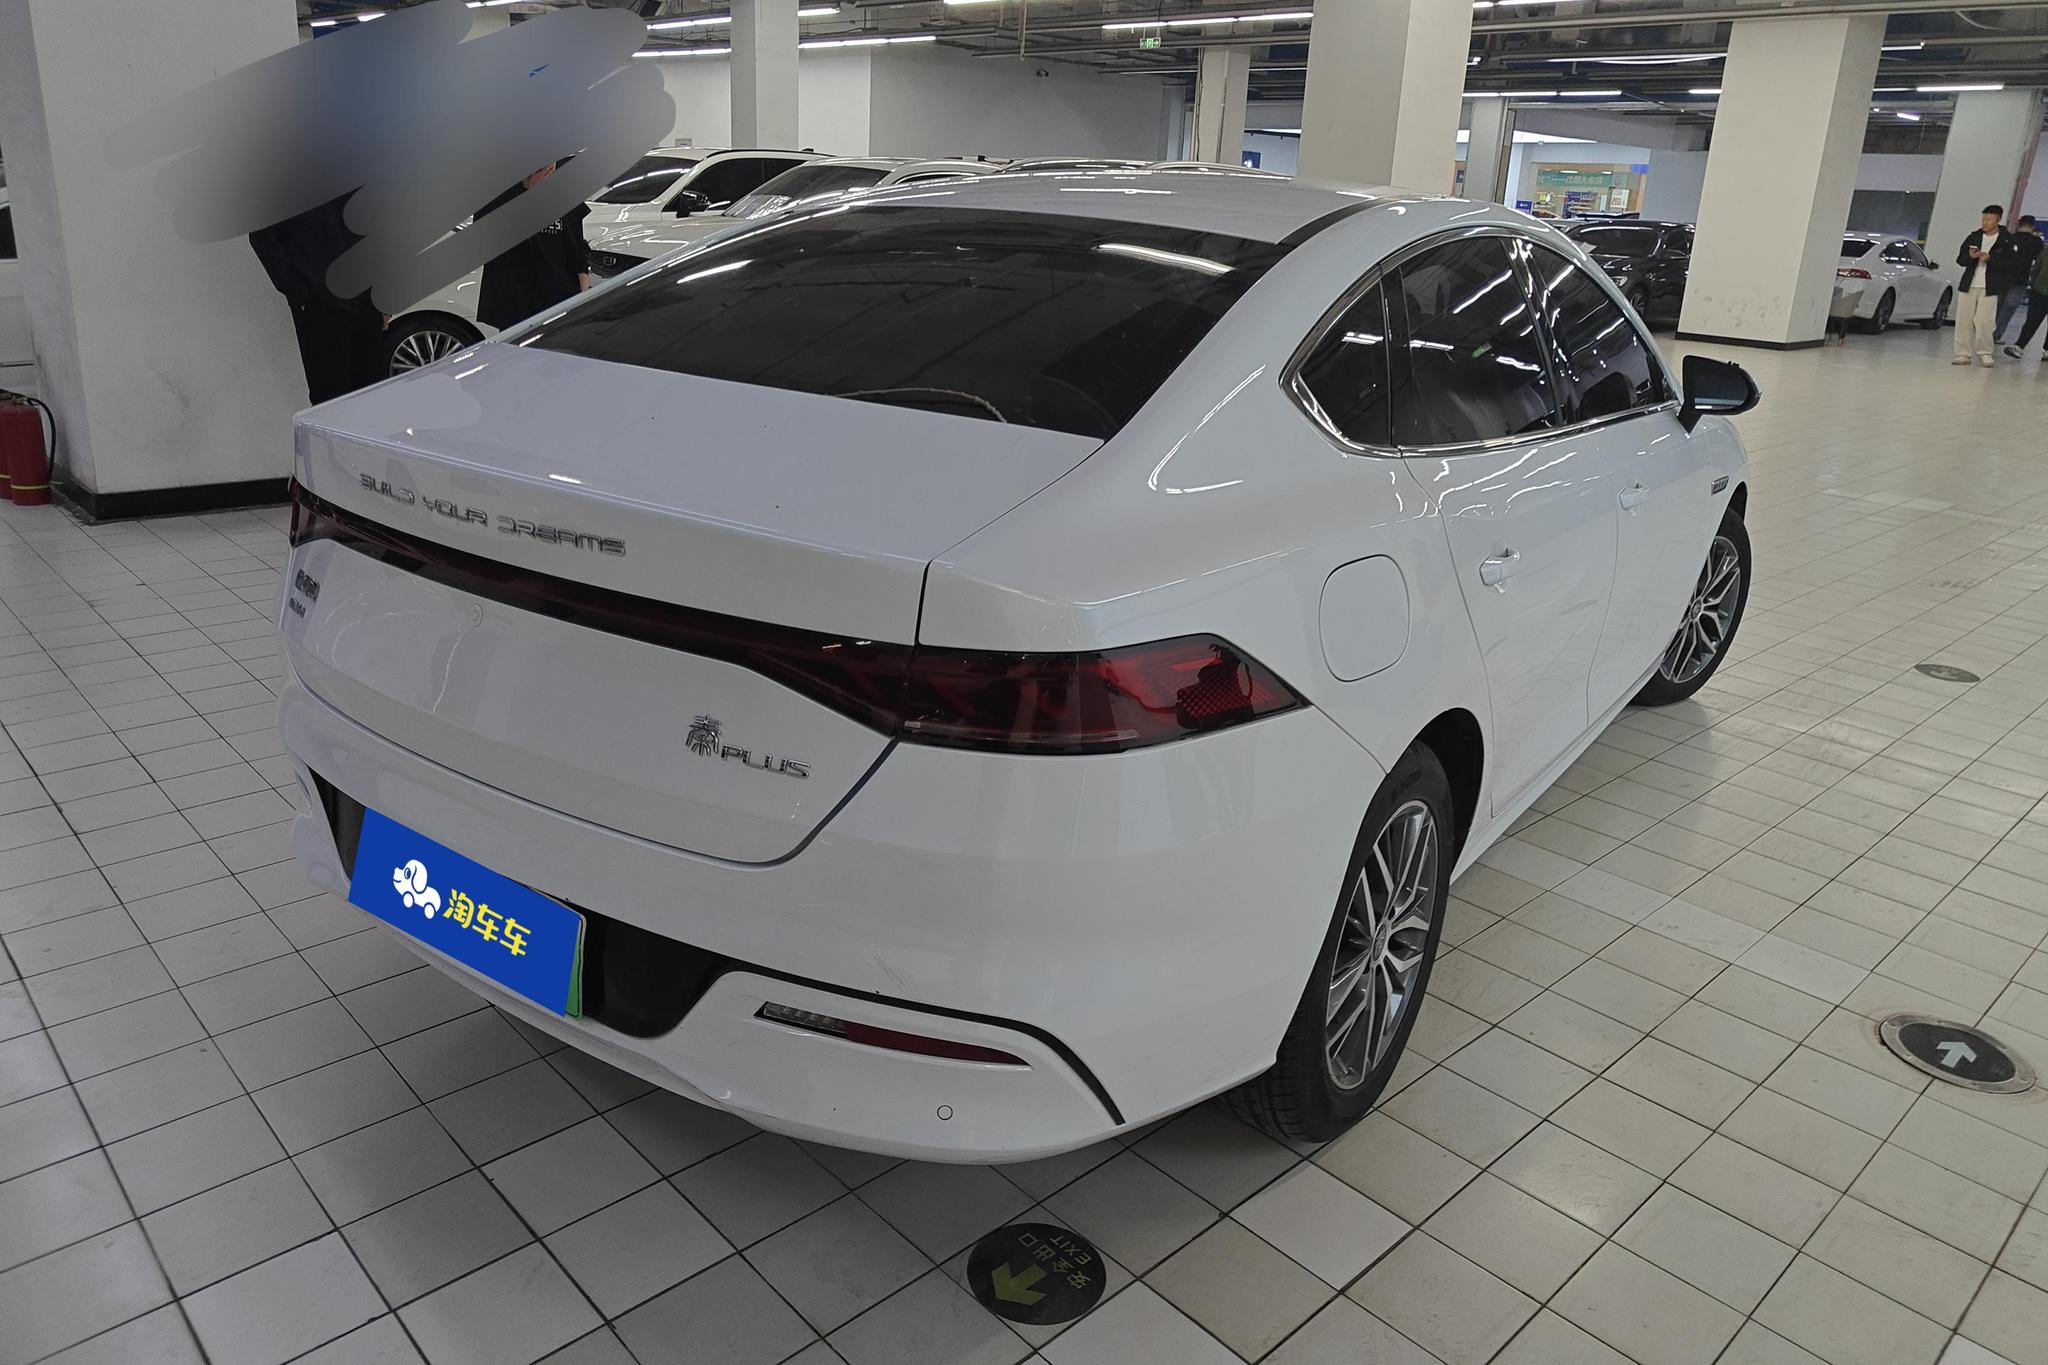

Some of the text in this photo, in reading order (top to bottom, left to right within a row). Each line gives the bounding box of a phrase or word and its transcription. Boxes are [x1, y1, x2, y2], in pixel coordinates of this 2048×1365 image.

[359, 473, 626, 557] BUILD YOUR DREAMS
[1018, 1233, 1092, 1288] 安全出口
[1050, 1235, 1092, 1265] EXIT
